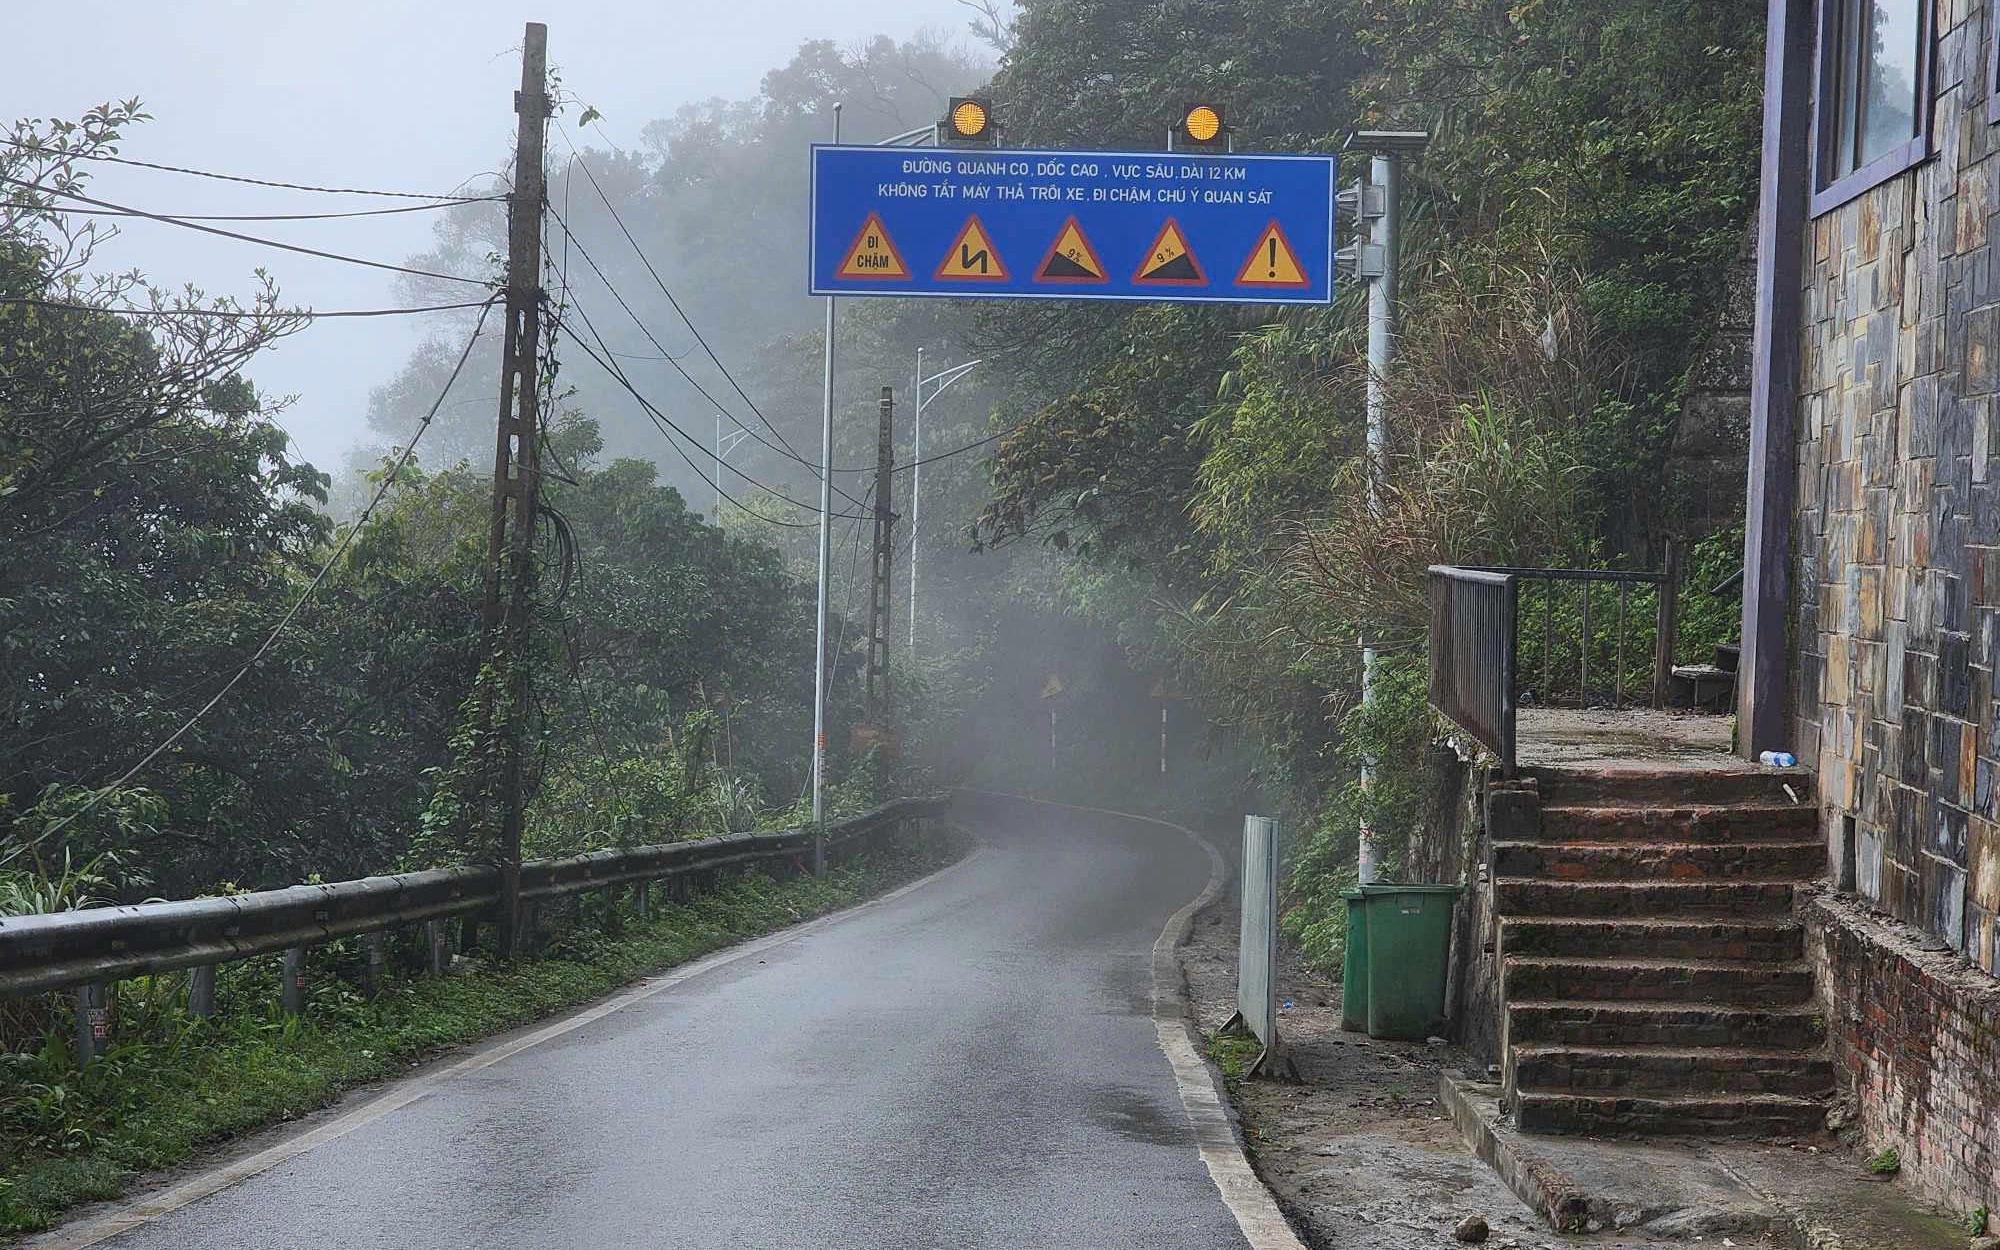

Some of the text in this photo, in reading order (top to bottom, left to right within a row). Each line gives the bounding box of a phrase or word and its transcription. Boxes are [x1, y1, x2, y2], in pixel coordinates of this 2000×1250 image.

[902, 157, 952, 174] ĐƯỜNG
[957, 161, 1006, 175] QUANH
[1037, 157, 1066, 176] DỐC
[1112, 164, 1141, 180] VỰC
[1181, 163, 1204, 179] DÀI
[1208, 167, 1221, 179] 12
[1224, 167, 1246, 180] KM
[878, 182, 928, 197] KHÔNG
[932, 179, 957, 198] TẮT
[962, 182, 991, 199] MÁY
[996, 182, 1025, 200] THẢ
[1030, 184, 1061, 200] TRÔI
[1093, 189, 1107, 201] ĐI
[1157, 186, 1186, 203] CHÚ
[1191, 187, 1200, 203] Ý
[1204, 190, 1244, 204] QUAN
[1247, 188, 1273, 204] SÁT
[867, 235, 879, 249] ĐI
[1066, 247, 1082, 263] 9%
